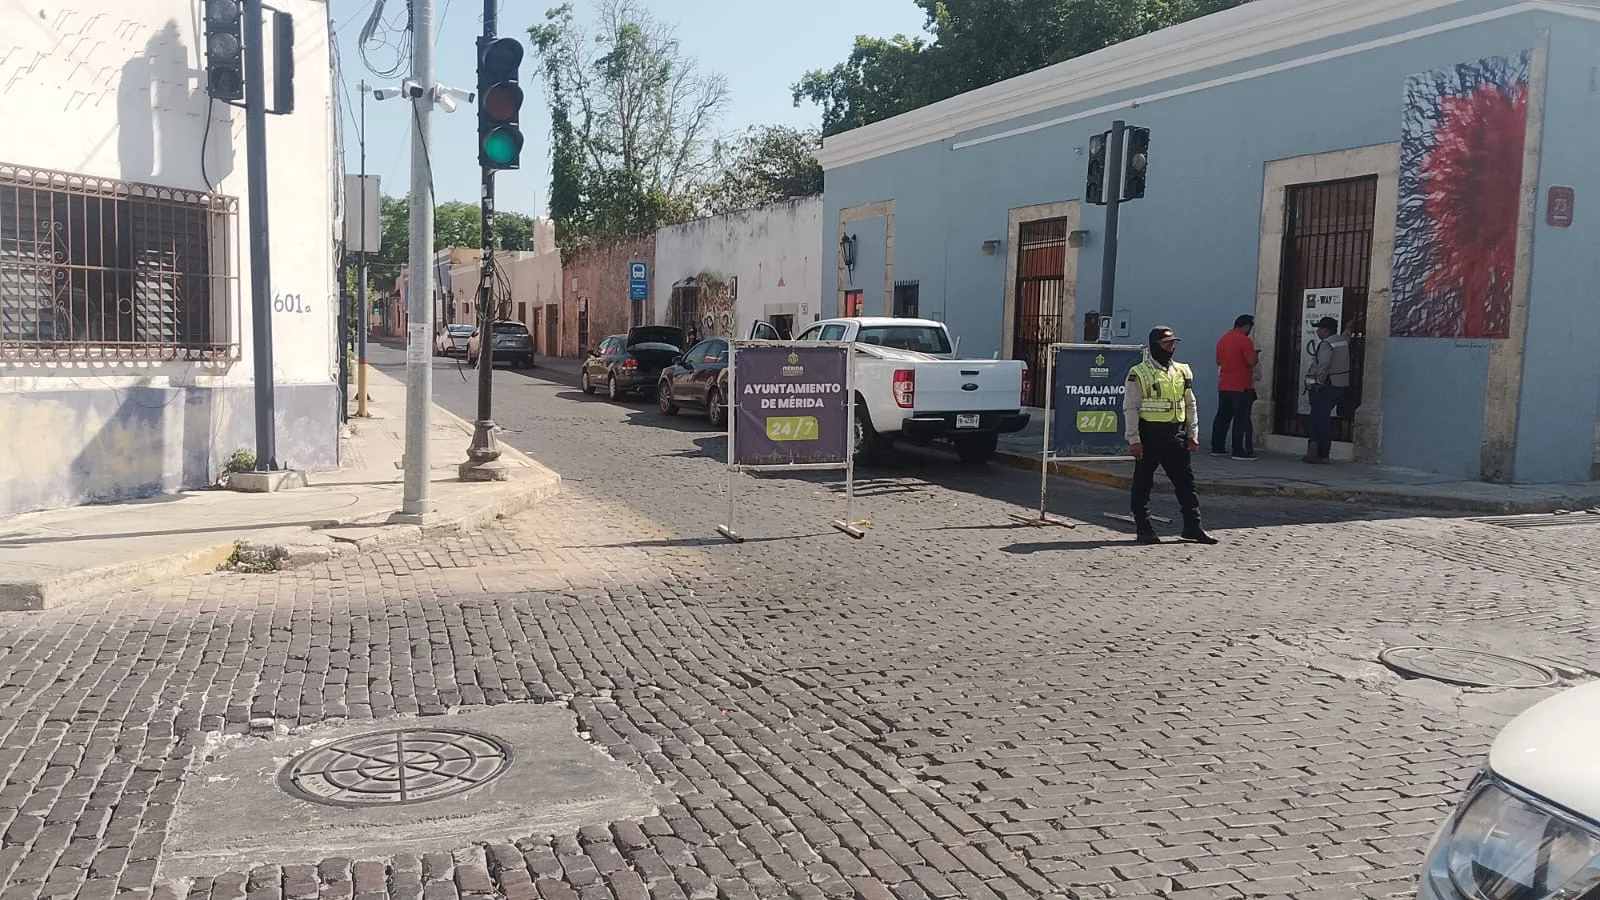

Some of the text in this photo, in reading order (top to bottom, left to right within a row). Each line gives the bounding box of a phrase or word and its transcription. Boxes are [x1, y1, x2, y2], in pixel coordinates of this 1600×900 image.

[1320, 296, 1333, 304] WAY
[743, 383, 841, 395] AYUNTAMIENTO
[1065, 385, 1125, 395] TRABAJAMO
[761, 395, 824, 409] DE MÉRIDA
[1080, 397, 1116, 406] PARA TI
[1080, 413, 1114, 430] 24/7
